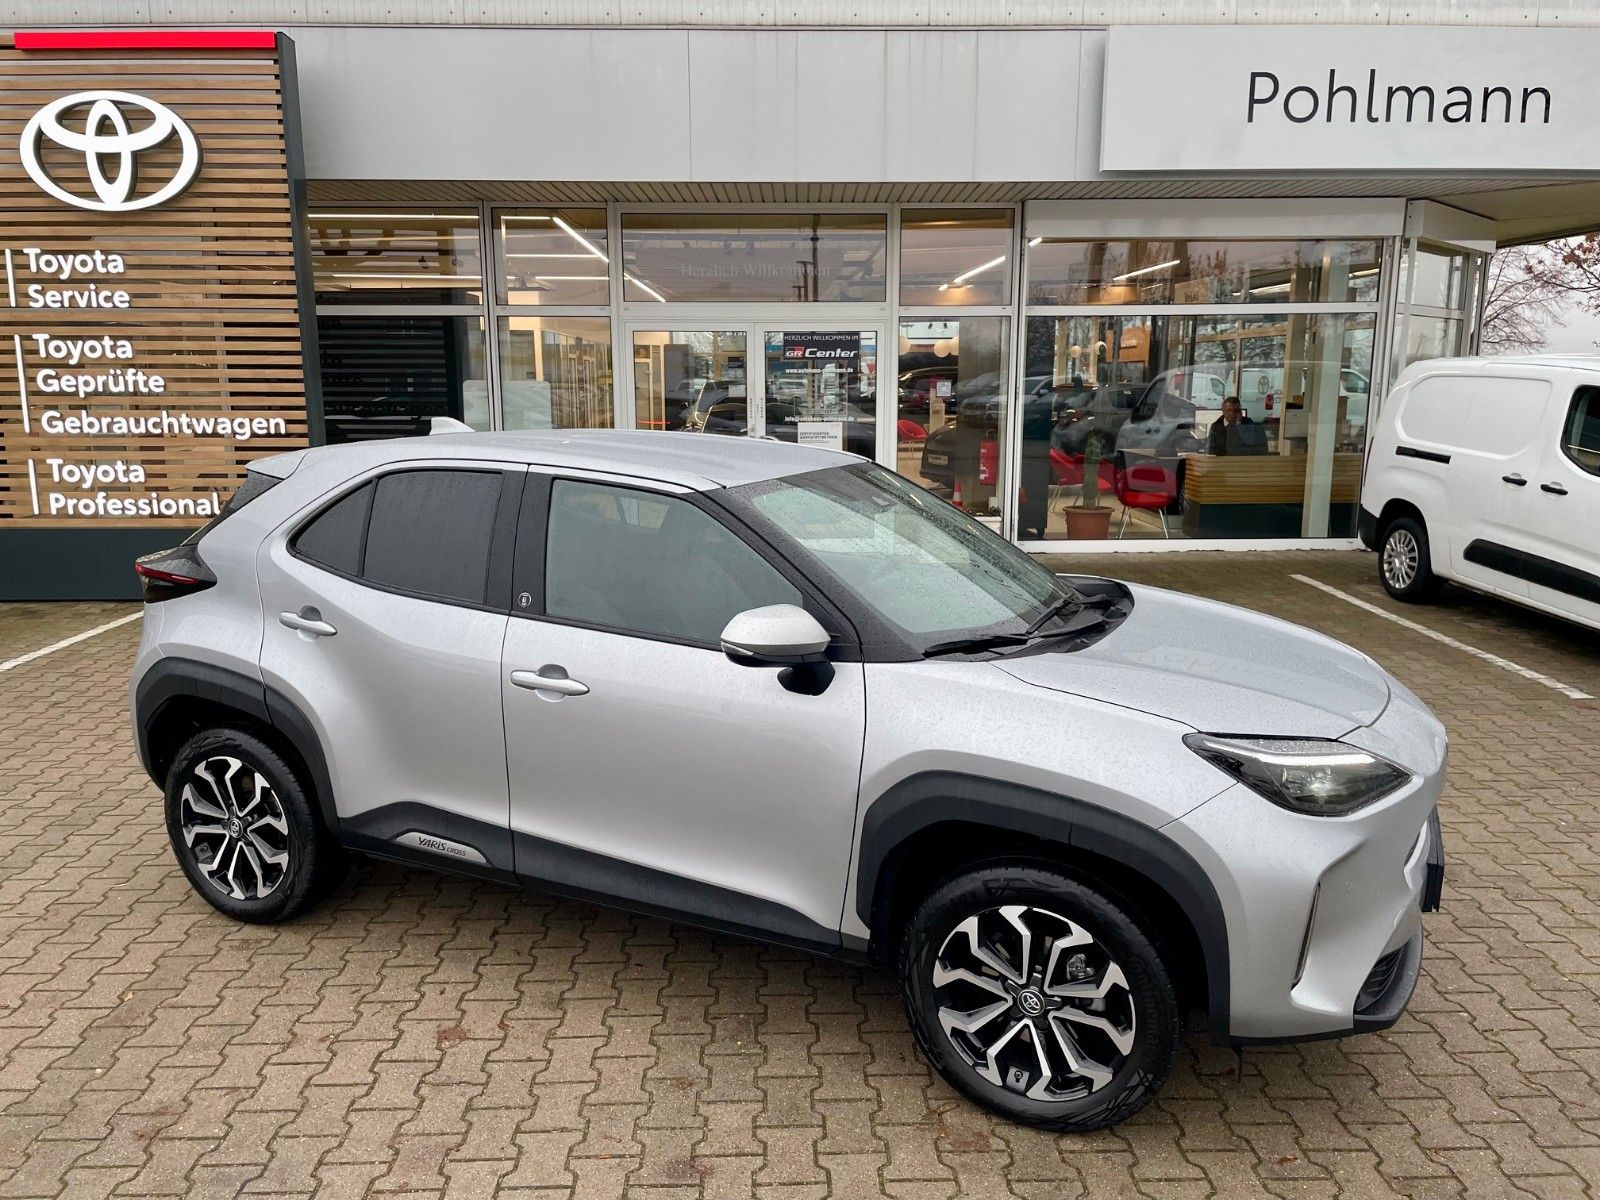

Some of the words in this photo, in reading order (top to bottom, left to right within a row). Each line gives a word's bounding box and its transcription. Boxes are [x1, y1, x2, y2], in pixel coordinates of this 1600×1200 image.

[1247, 69, 1552, 124] Pohlmann
[23, 248, 125, 279] Toyota
[27, 284, 130, 308] Service
[32, 334, 133, 364] Toyota
[786, 350, 803, 358] GR
[804, 348, 859, 358] Center
[36, 368, 166, 398] Geprüfte
[41, 410, 287, 440] Gebrauchtwagen
[46, 459, 146, 488] Toyota
[49, 492, 221, 516] Professional
[419, 836, 447, 851] YARIS
[447, 847, 466, 856] CROSS
